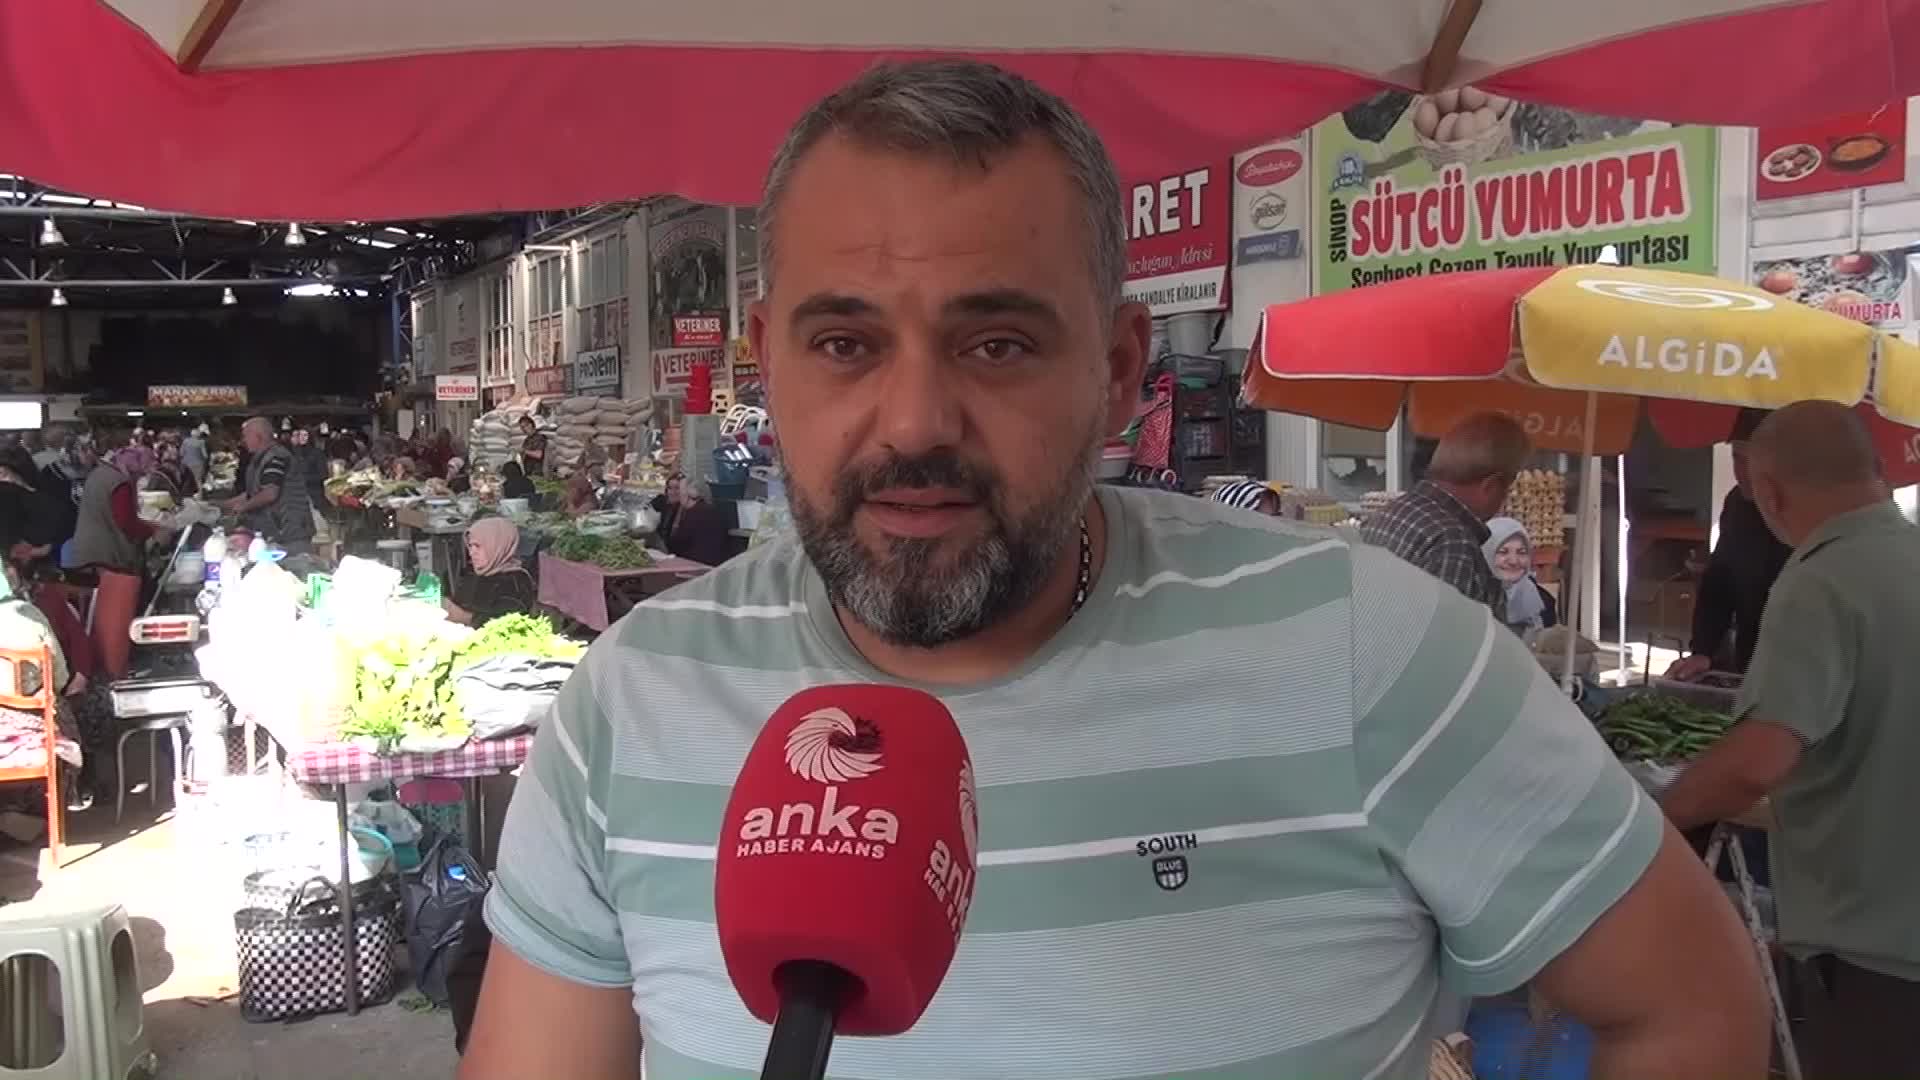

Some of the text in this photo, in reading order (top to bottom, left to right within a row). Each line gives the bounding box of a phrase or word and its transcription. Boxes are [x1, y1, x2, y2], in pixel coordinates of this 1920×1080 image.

[1123, 169, 1209, 241] RET
[1328, 198, 1348, 263] SİNOP
[1351, 148, 1685, 256] SÜTCÜ YUMURTA
[740, 786, 899, 844] anka
[1136, 833, 1197, 857] SOUTH
[737, 836, 886, 860] HABER AJANS
[1156, 859, 1183, 872] BLUE
[930, 839, 974, 929] ank
